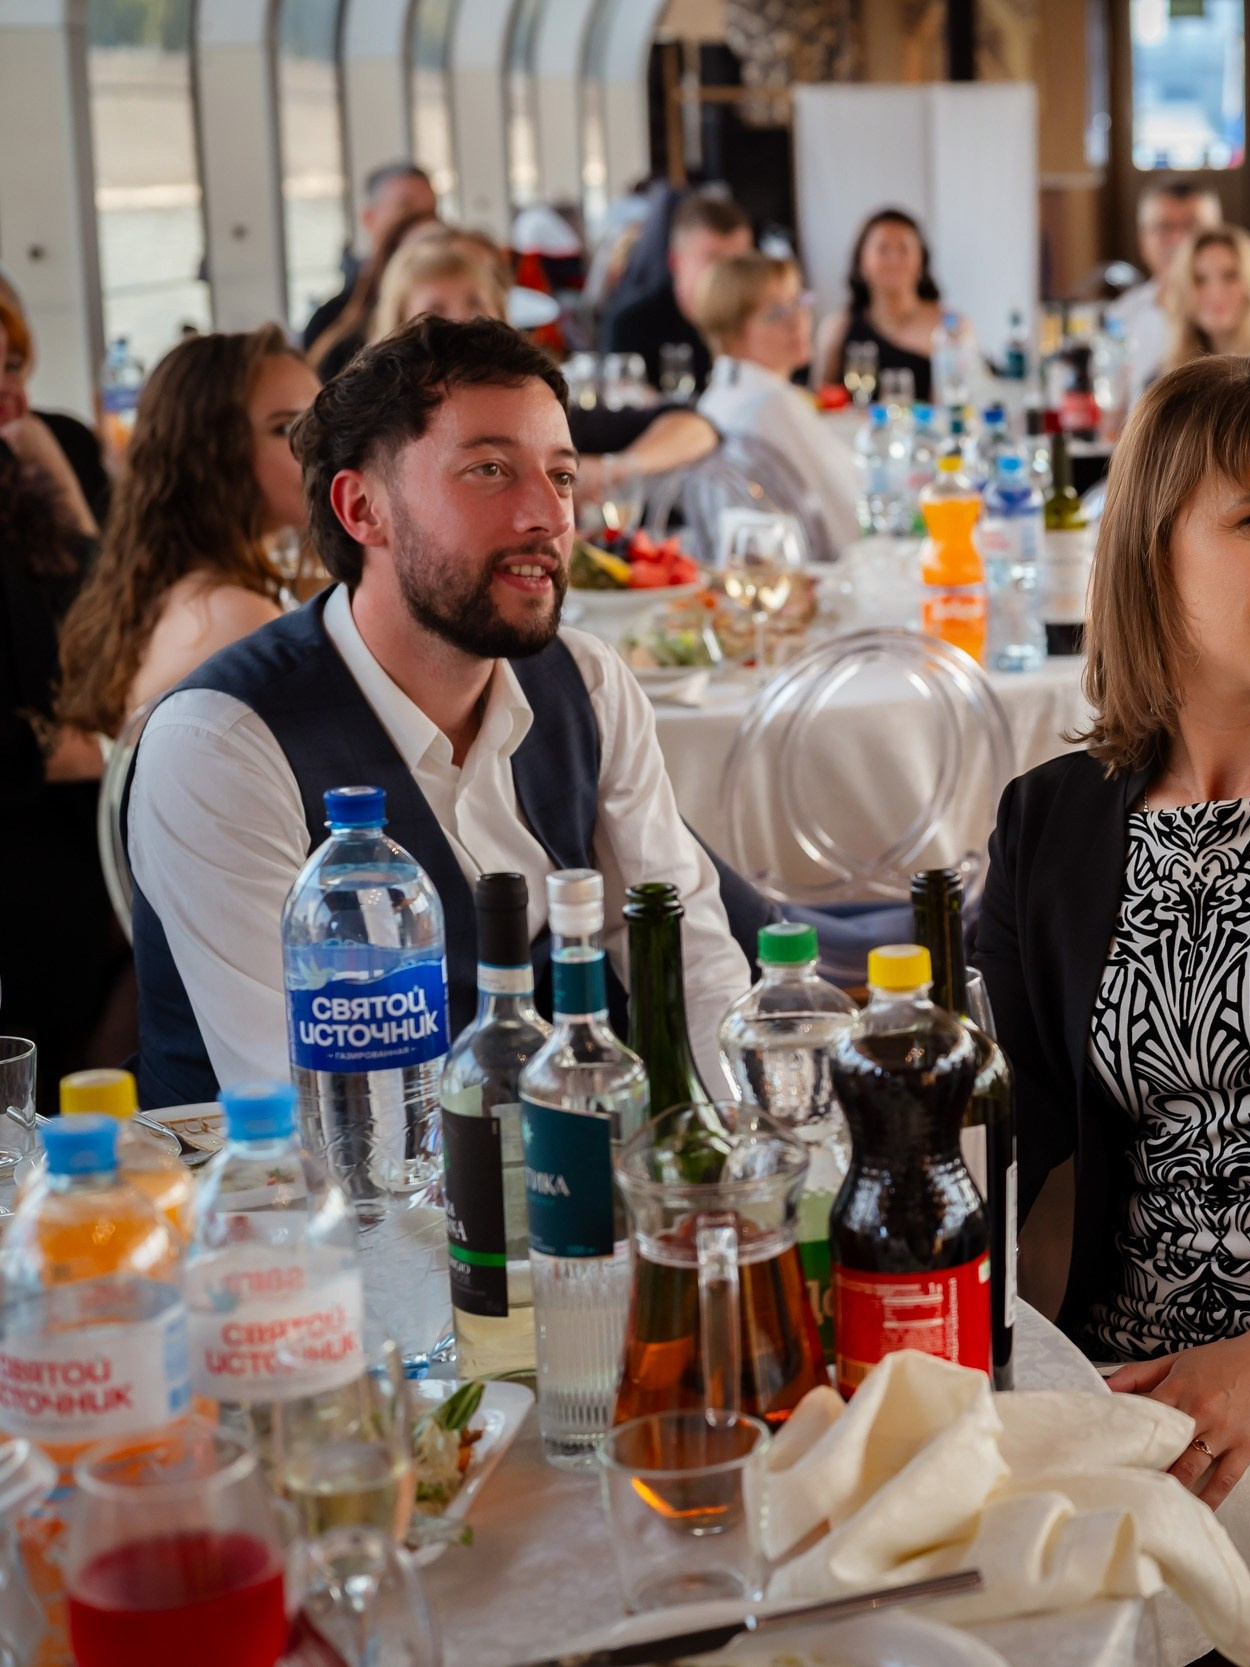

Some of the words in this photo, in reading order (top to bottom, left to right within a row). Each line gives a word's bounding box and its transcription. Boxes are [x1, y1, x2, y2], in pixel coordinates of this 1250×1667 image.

[311, 984, 426, 1021] СВЯТОЙ
[300, 1010, 439, 1047] ИСТОЧНИК
[204, 1330, 358, 1376] ИСТОНИК
